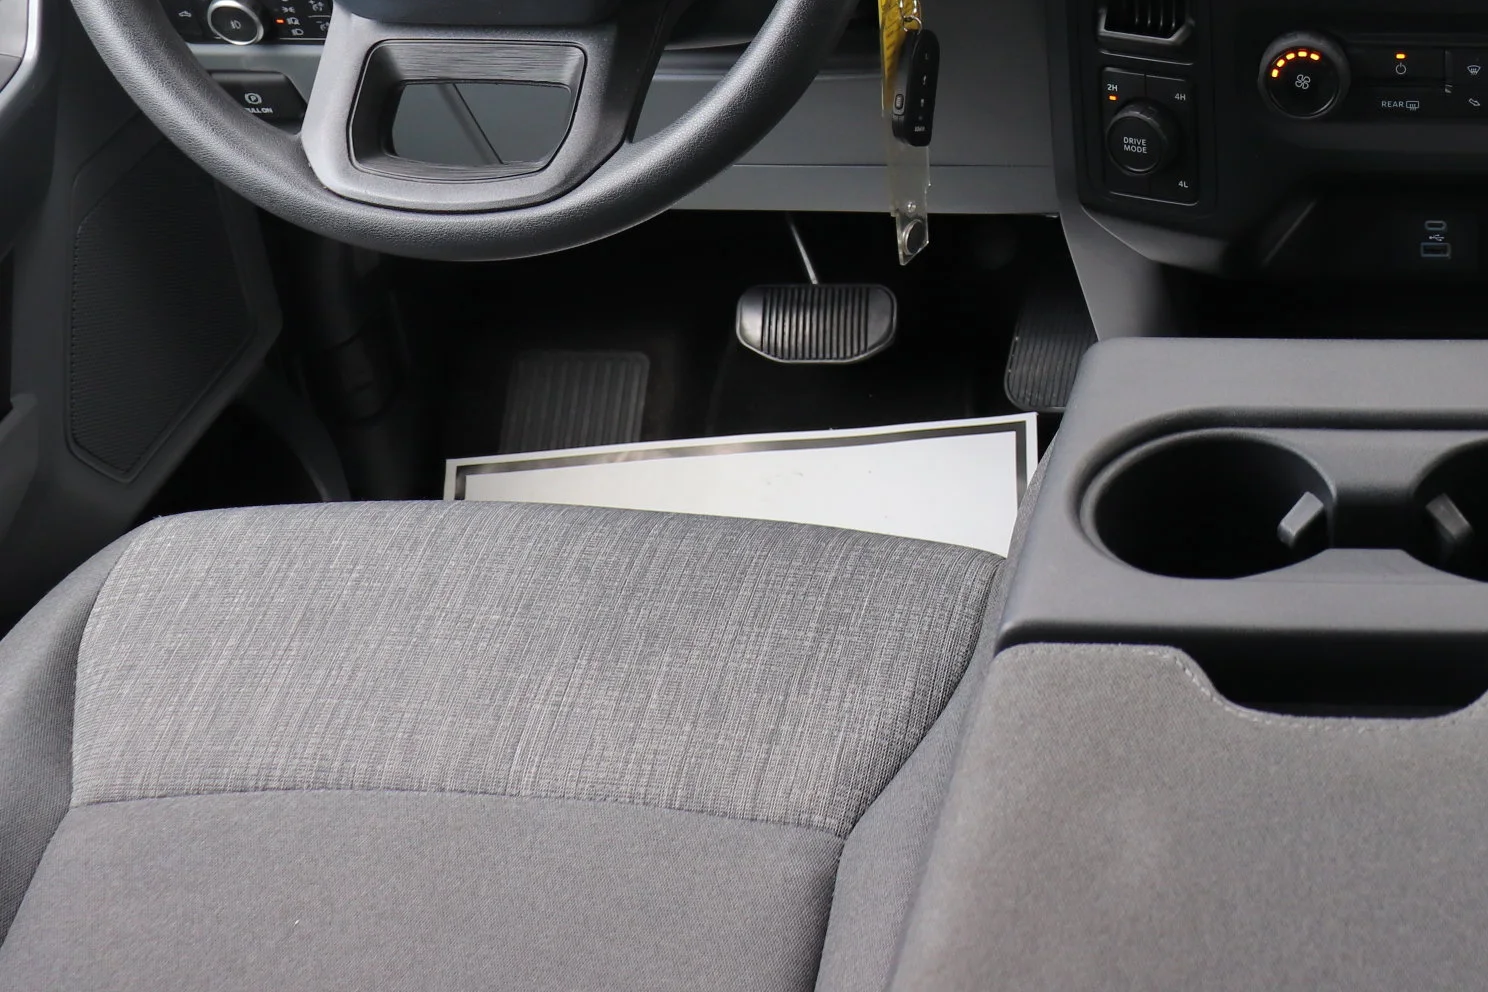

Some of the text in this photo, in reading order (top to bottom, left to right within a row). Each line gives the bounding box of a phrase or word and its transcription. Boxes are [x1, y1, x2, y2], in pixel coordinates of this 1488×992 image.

[1107, 83, 1118, 92] 2H
[1175, 92, 1186, 101] 4H
[1381, 100, 1405, 108] REAR
[1123, 136, 1147, 146] DRIVE
[1123, 144, 1148, 154] MODE
[1178, 180, 1189, 188] 4L
